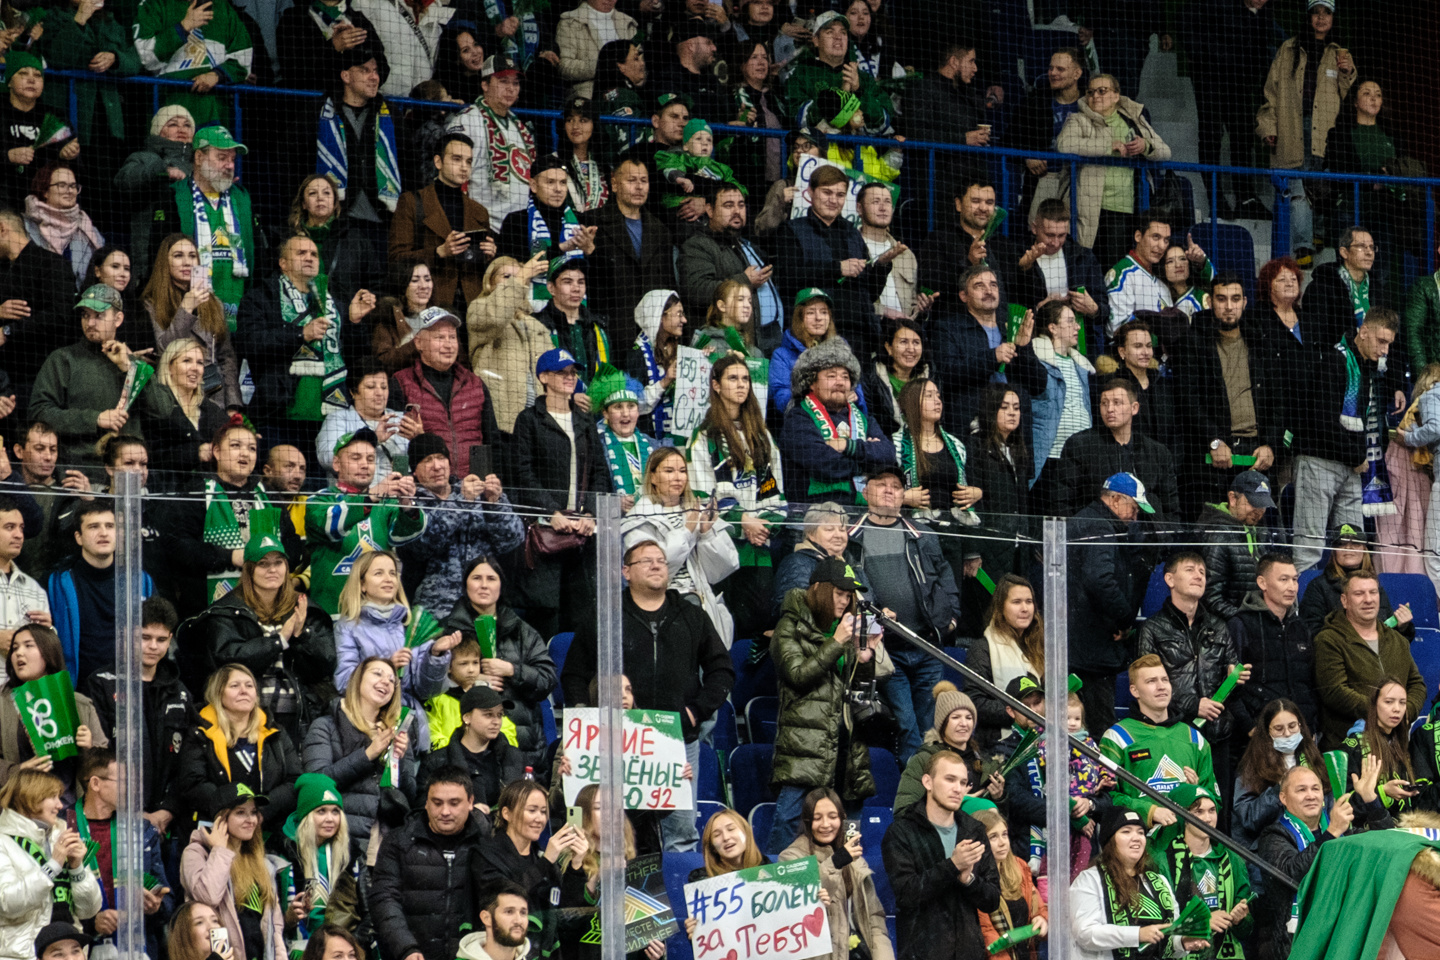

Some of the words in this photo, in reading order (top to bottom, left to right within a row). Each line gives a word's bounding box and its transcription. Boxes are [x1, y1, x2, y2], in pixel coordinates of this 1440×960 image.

[565, 717, 655, 757] ЯРИЕ
[576, 754, 684, 788] ЗЕЁНЫЕ
[688, 882, 747, 926] #55
